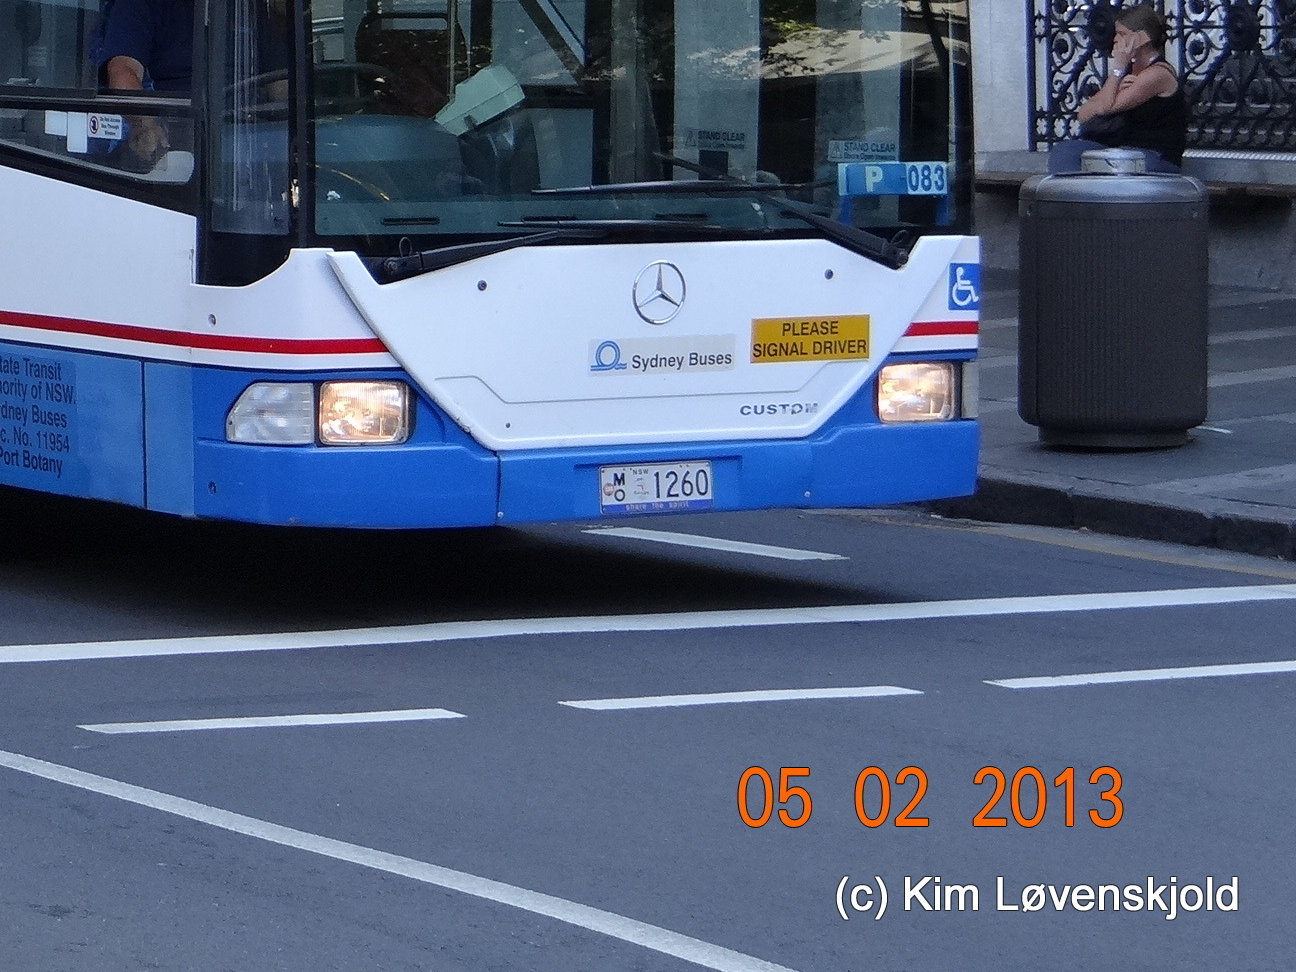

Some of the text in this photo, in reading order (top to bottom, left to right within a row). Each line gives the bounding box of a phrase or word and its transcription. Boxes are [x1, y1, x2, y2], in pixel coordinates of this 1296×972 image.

[698, 131, 745, 141] STAND CLEAR
[844, 142, 895, 153] STAND CLEAR
[866, 164, 944, 193] P 083
[782, 320, 839, 337] PLEASE
[753, 339, 867, 358] SIGNAL DRIVER
[23, 357, 62, 381] Transit
[631, 352, 732, 375] Sydney Buses
[31, 381, 43, 400] of
[46, 382, 76, 405] NSW.
[32, 404, 67, 428] Buses
[14, 427, 32, 447] No.
[36, 431, 70, 453] 11954
[23, 450, 63, 478] Botany
[613, 473, 625, 486] M
[653, 469, 709, 499] 1260
